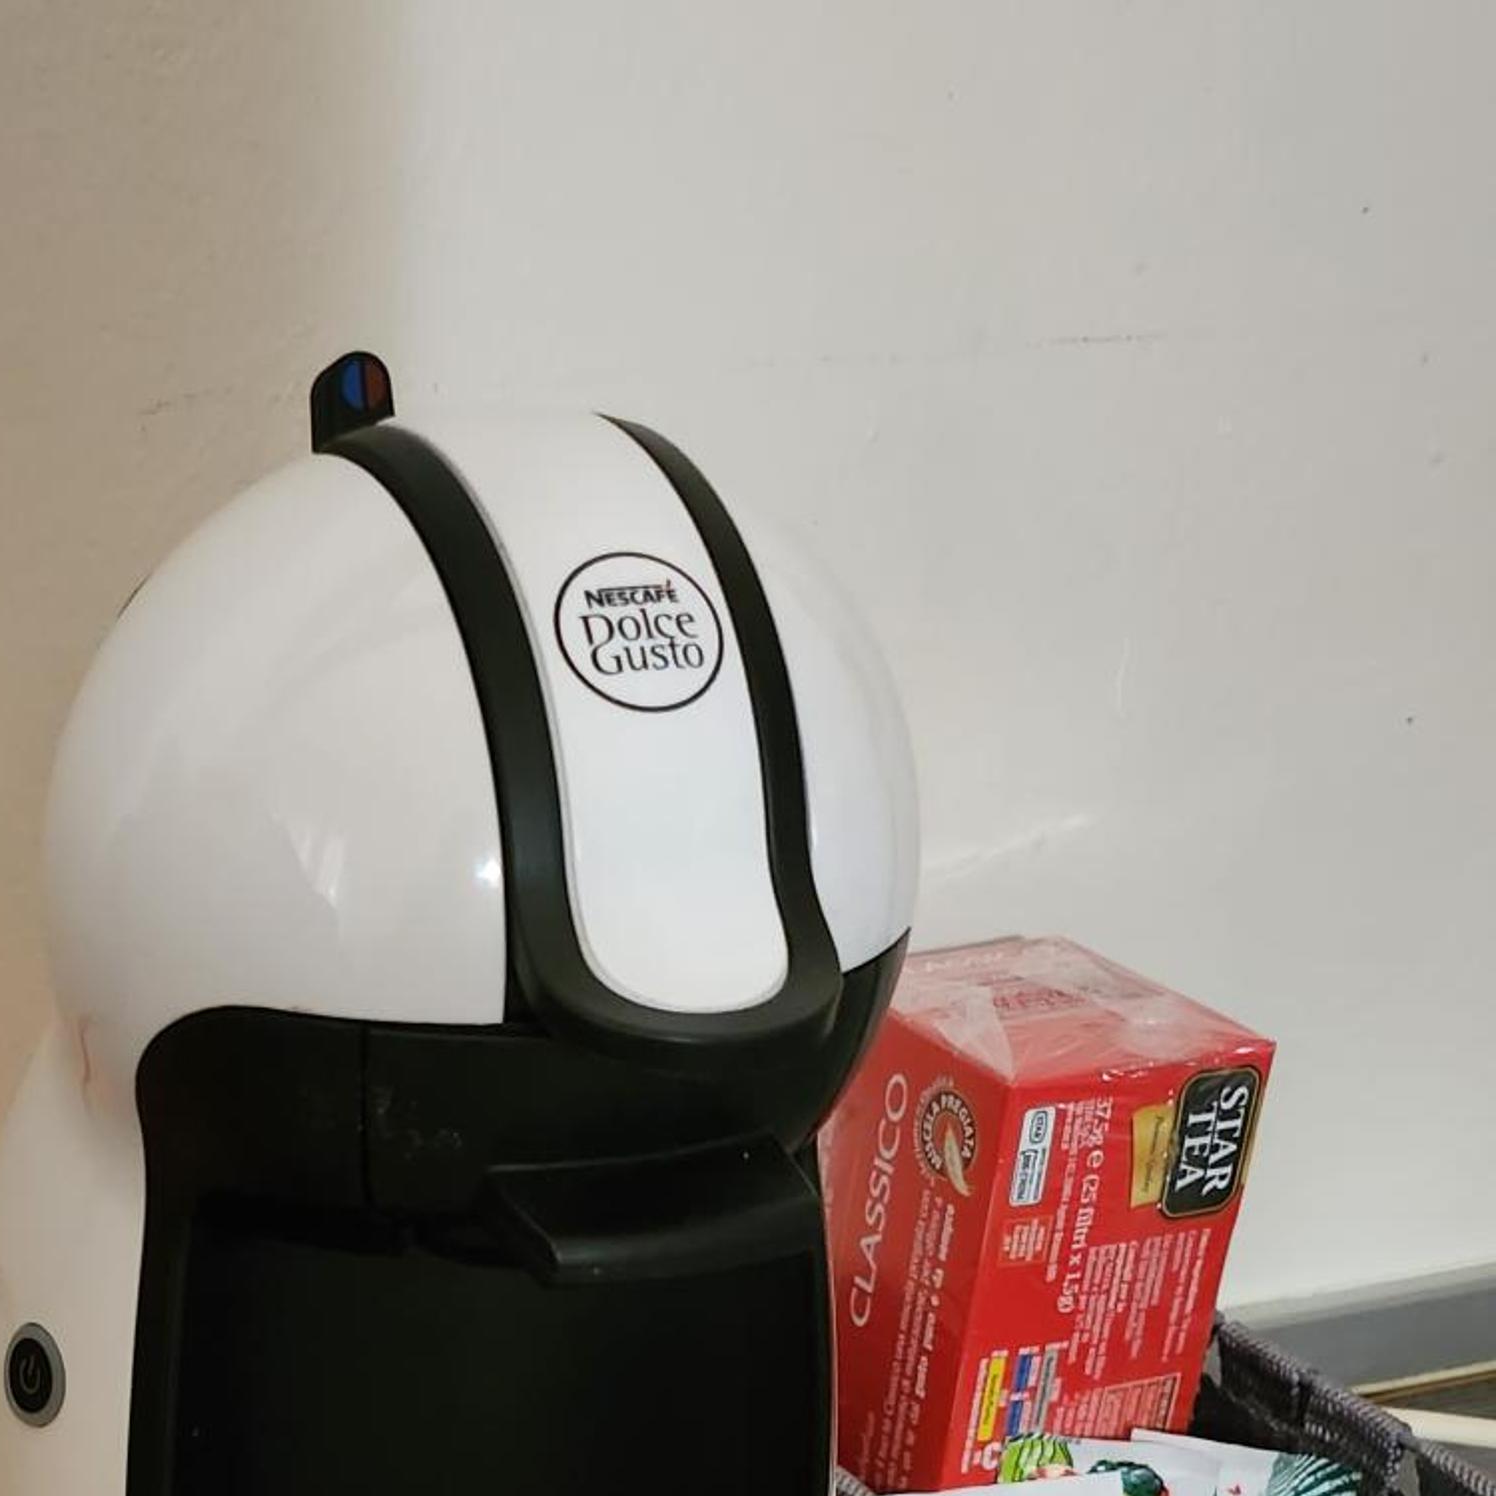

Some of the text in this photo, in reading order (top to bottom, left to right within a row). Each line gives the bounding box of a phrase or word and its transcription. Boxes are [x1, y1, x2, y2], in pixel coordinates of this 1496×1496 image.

[578, 608, 700, 646] Dolce
[591, 637, 704, 675] Gusto
[1174, 1104, 1219, 1193] TEA
[1201, 1084, 1250, 1198] STAR
[849, 1073, 907, 1328] CLASSICO
